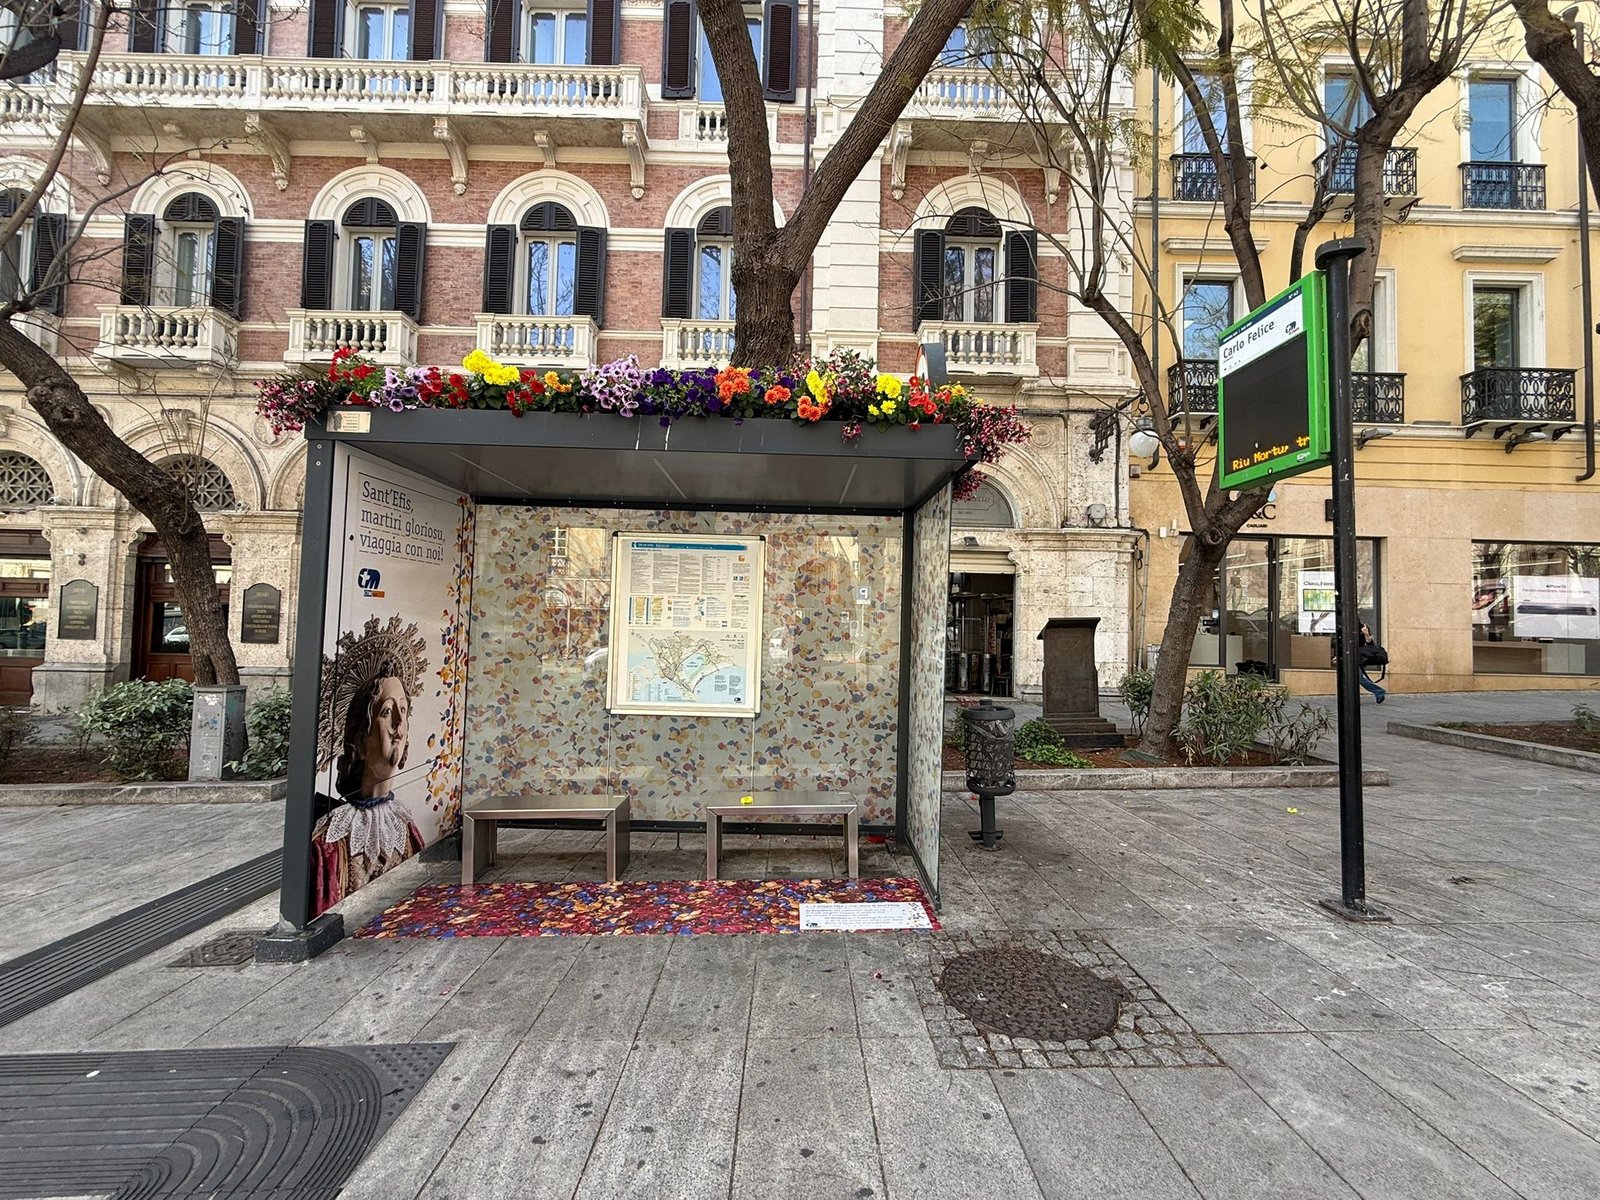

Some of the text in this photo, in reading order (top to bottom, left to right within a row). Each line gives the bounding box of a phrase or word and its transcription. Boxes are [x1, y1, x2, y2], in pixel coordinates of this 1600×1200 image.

[1223, 339, 1245, 359] Carlo
[1247, 321, 1275, 344] Felice
[1232, 458, 1251, 471] Riu
[362, 480, 414, 513] Sant'Efis,
[361, 509, 446, 543] martiri gloriosu,
[360, 530, 444, 561] viaggia con noi!
